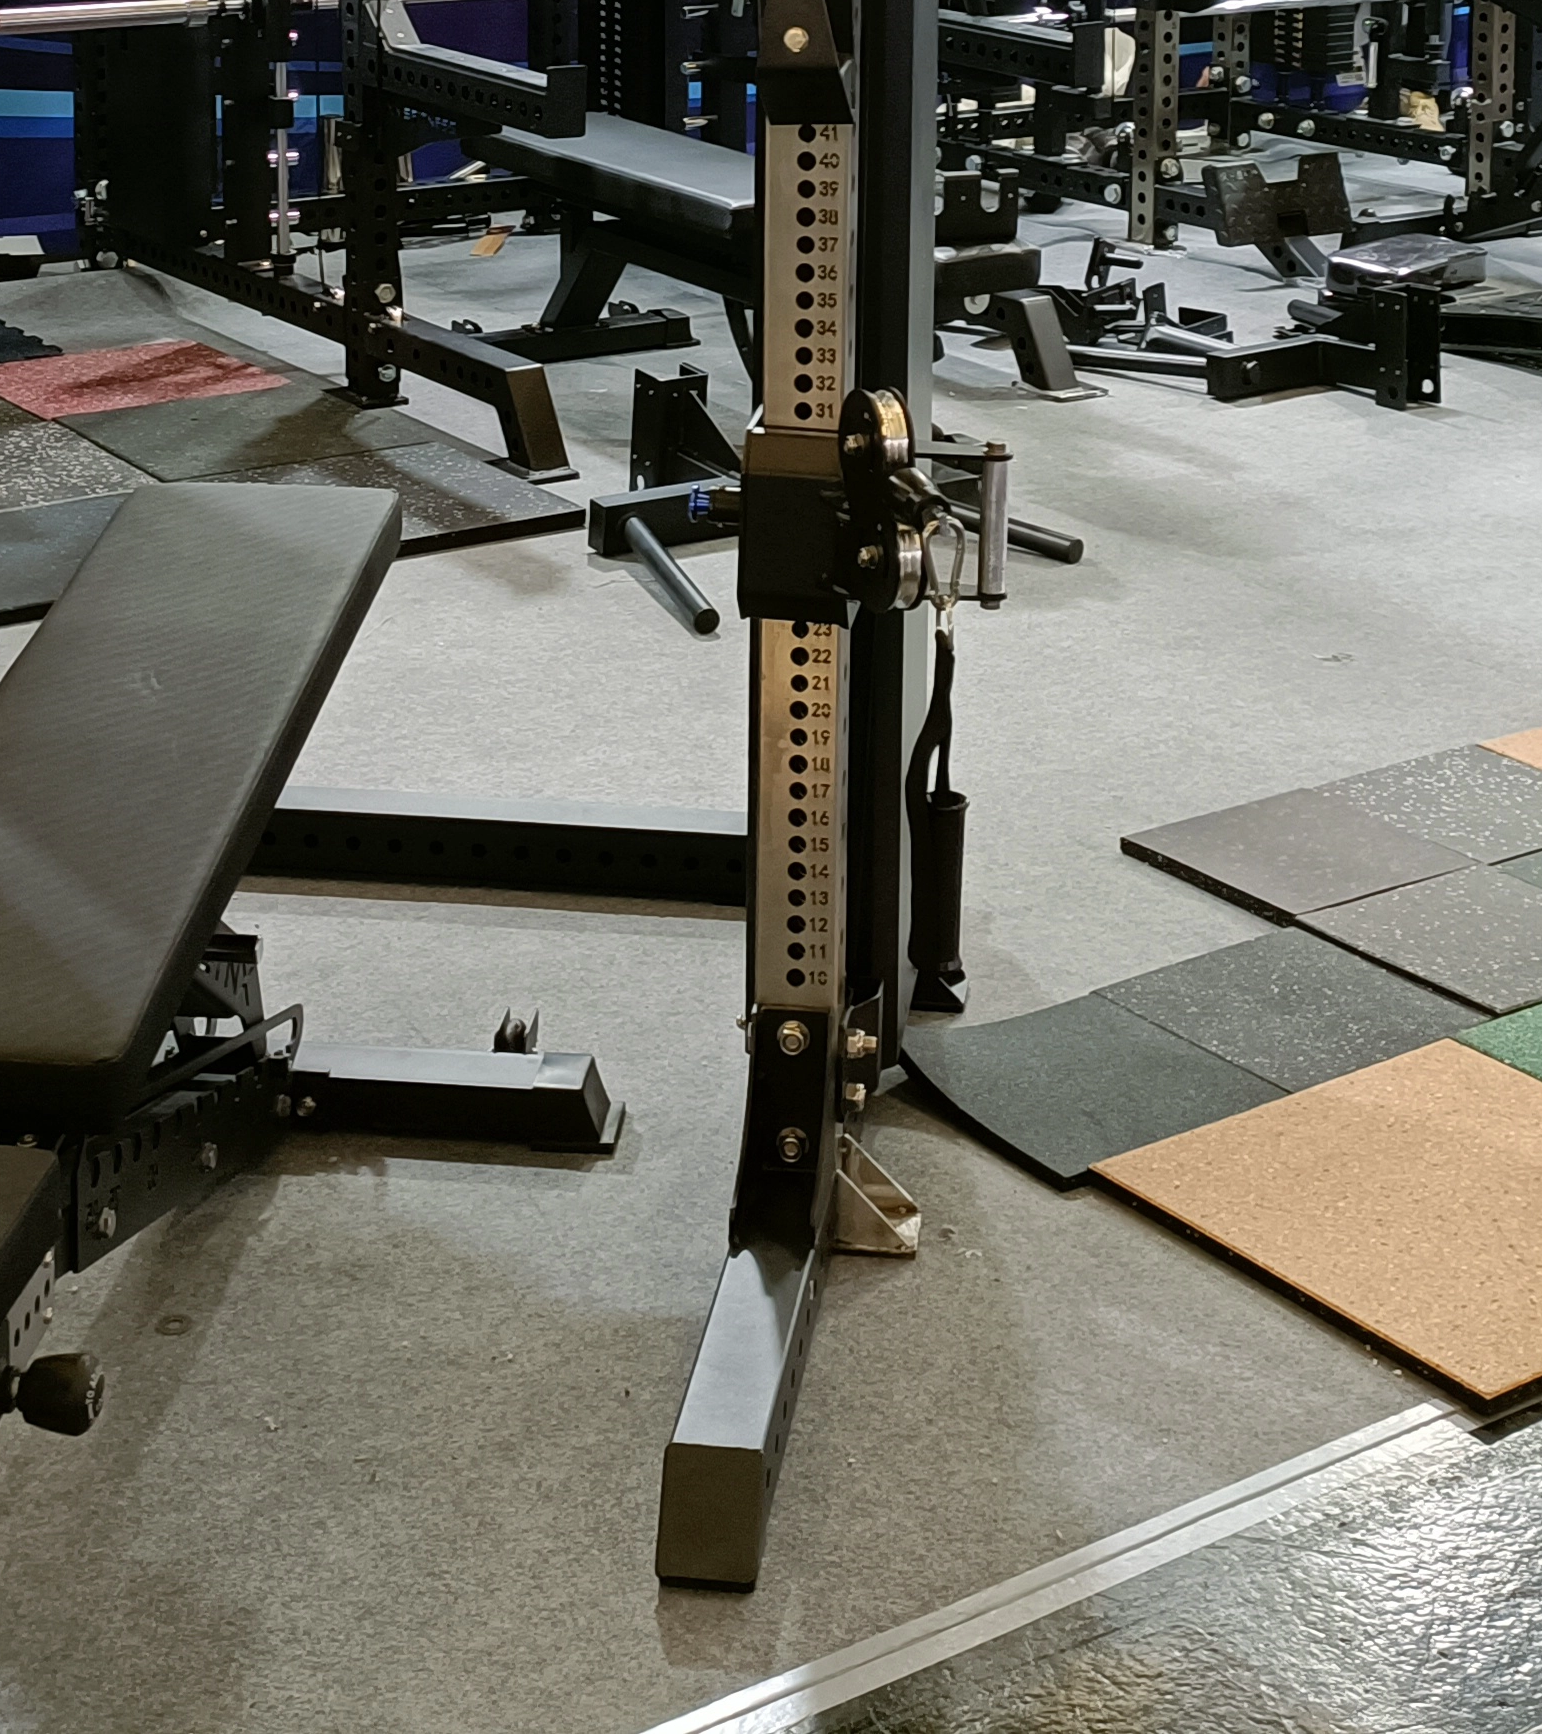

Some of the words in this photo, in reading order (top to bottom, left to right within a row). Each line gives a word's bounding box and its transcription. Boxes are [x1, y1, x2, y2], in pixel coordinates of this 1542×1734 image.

[819, 125, 838, 141] 41
[819, 153, 839, 169] 40
[820, 181, 839, 197] 39
[818, 209, 838, 225] 38
[818, 237, 838, 252] 37
[818, 265, 837, 281] 36
[817, 293, 837, 308] 35
[817, 320, 837, 336] 34
[817, 348, 836, 364] 33
[816, 376, 836, 391] 32
[816, 403, 833, 419] 31
[812, 623, 831, 637] 23
[812, 649, 831, 664] 22
[812, 676, 830, 691] 21
[812, 703, 831, 719] 20
[812, 730, 830, 746] 19
[812, 784, 830, 798] 17
[811, 811, 829, 826] 16
[811, 837, 829, 852] 15
[810, 864, 829, 879] 14
[810, 891, 828, 906] 13
[810, 917, 827, 932] 12
[810, 944, 826, 959] 11
[809, 971, 827, 985] 10
